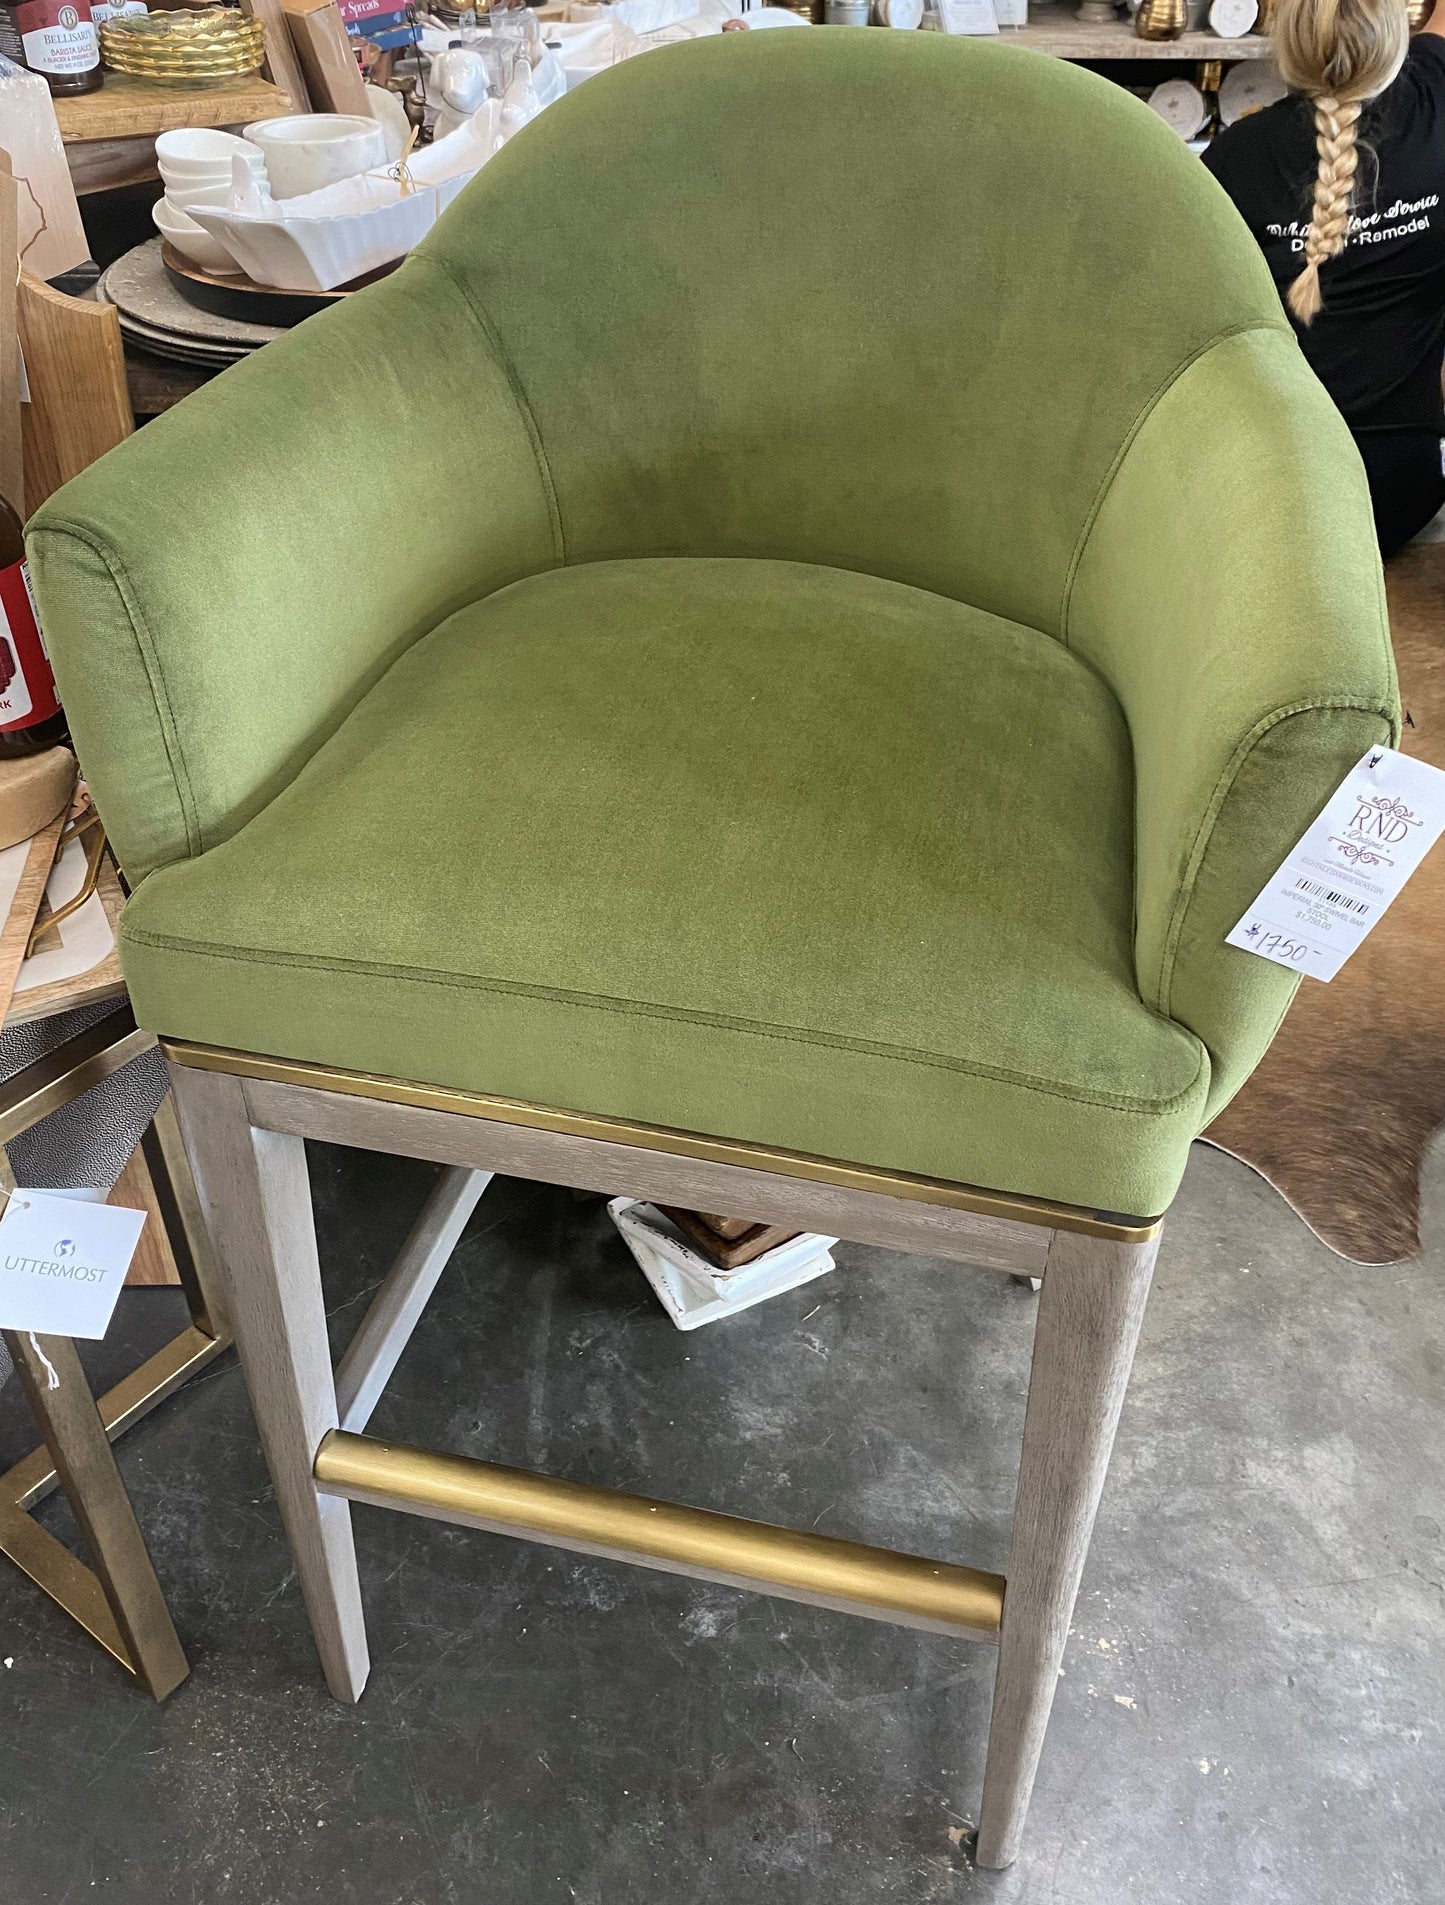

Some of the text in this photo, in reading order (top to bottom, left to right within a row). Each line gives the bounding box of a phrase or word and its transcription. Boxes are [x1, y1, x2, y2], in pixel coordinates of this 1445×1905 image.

[63, 11, 74, 25] B
[348, 0, 380, 18] Spreads
[51, 47, 76, 57] BARISTA
[77, 44, 93, 54] SAUCE
[1347, 212, 1382, 232] love
[1383, 193, 1440, 219] Service
[1359, 215, 1431, 246] Remodel
[1348, 804, 1408, 843] RND
[1347, 829, 1385, 850] Designs
[1281, 888, 1311, 907] IMPERIAL
[1323, 905, 1349, 922] SWIVEL
[1349, 917, 1366, 928] BAR
[1306, 907, 1330, 922] STOOL
[1295, 910, 1332, 931] $1,750.00
[5, 1255, 109, 1283] UTTERMOST
